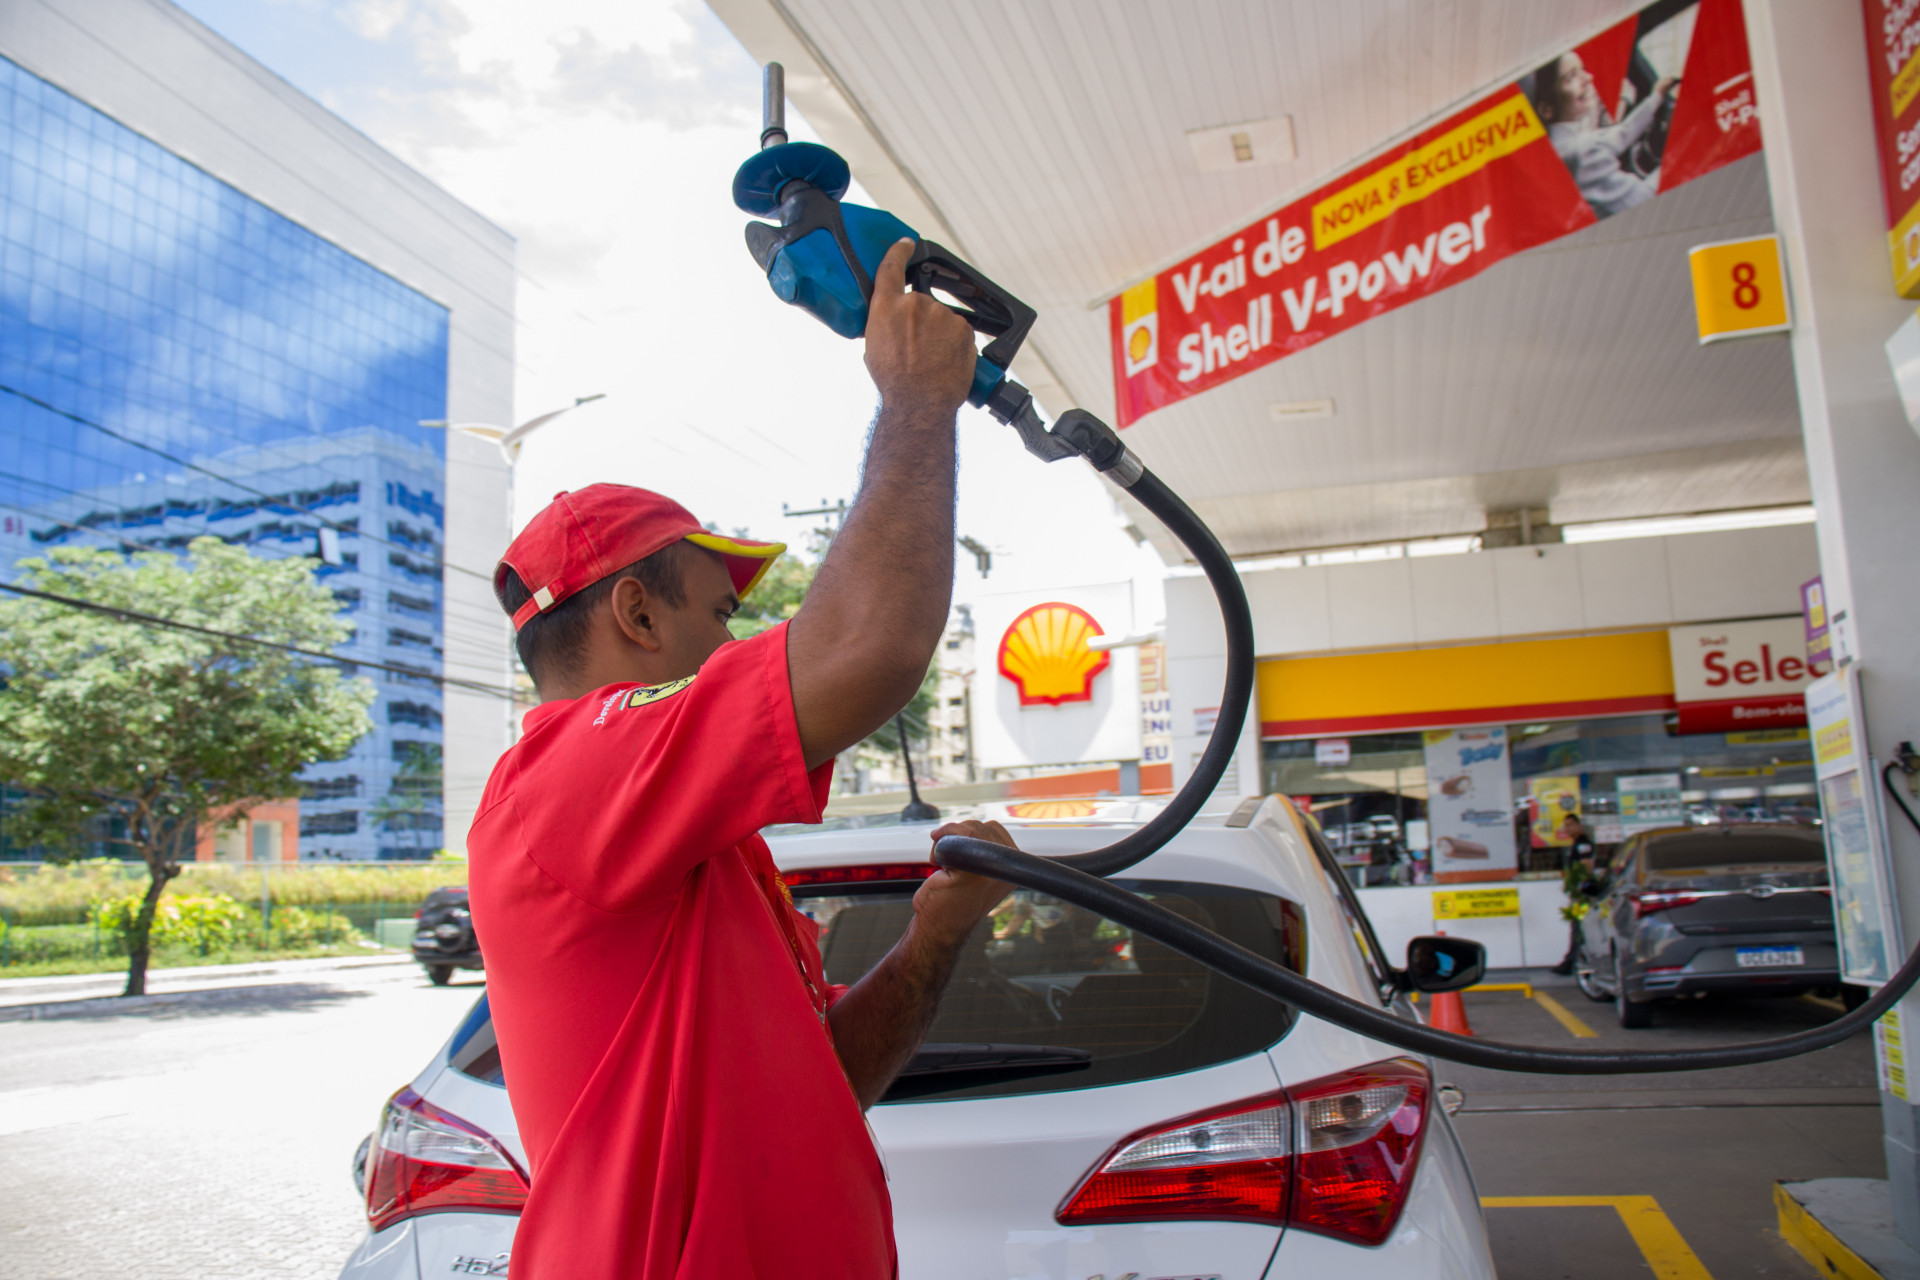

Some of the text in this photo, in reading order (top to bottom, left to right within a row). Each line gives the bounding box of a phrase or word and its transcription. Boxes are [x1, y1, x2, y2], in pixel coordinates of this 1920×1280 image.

[1321, 109, 1530, 234] NOVA & EXCLUSIVA
[1171, 218, 1305, 314] V-ai de
[1731, 261, 1760, 310] 8
[1177, 204, 1491, 382] Shell V-Power
[1699, 636, 1727, 646] Shell
[1703, 643, 1829, 688] Selec
[1732, 703, 1806, 719] Bem-vin
[450, 1252, 511, 1277] HB2
